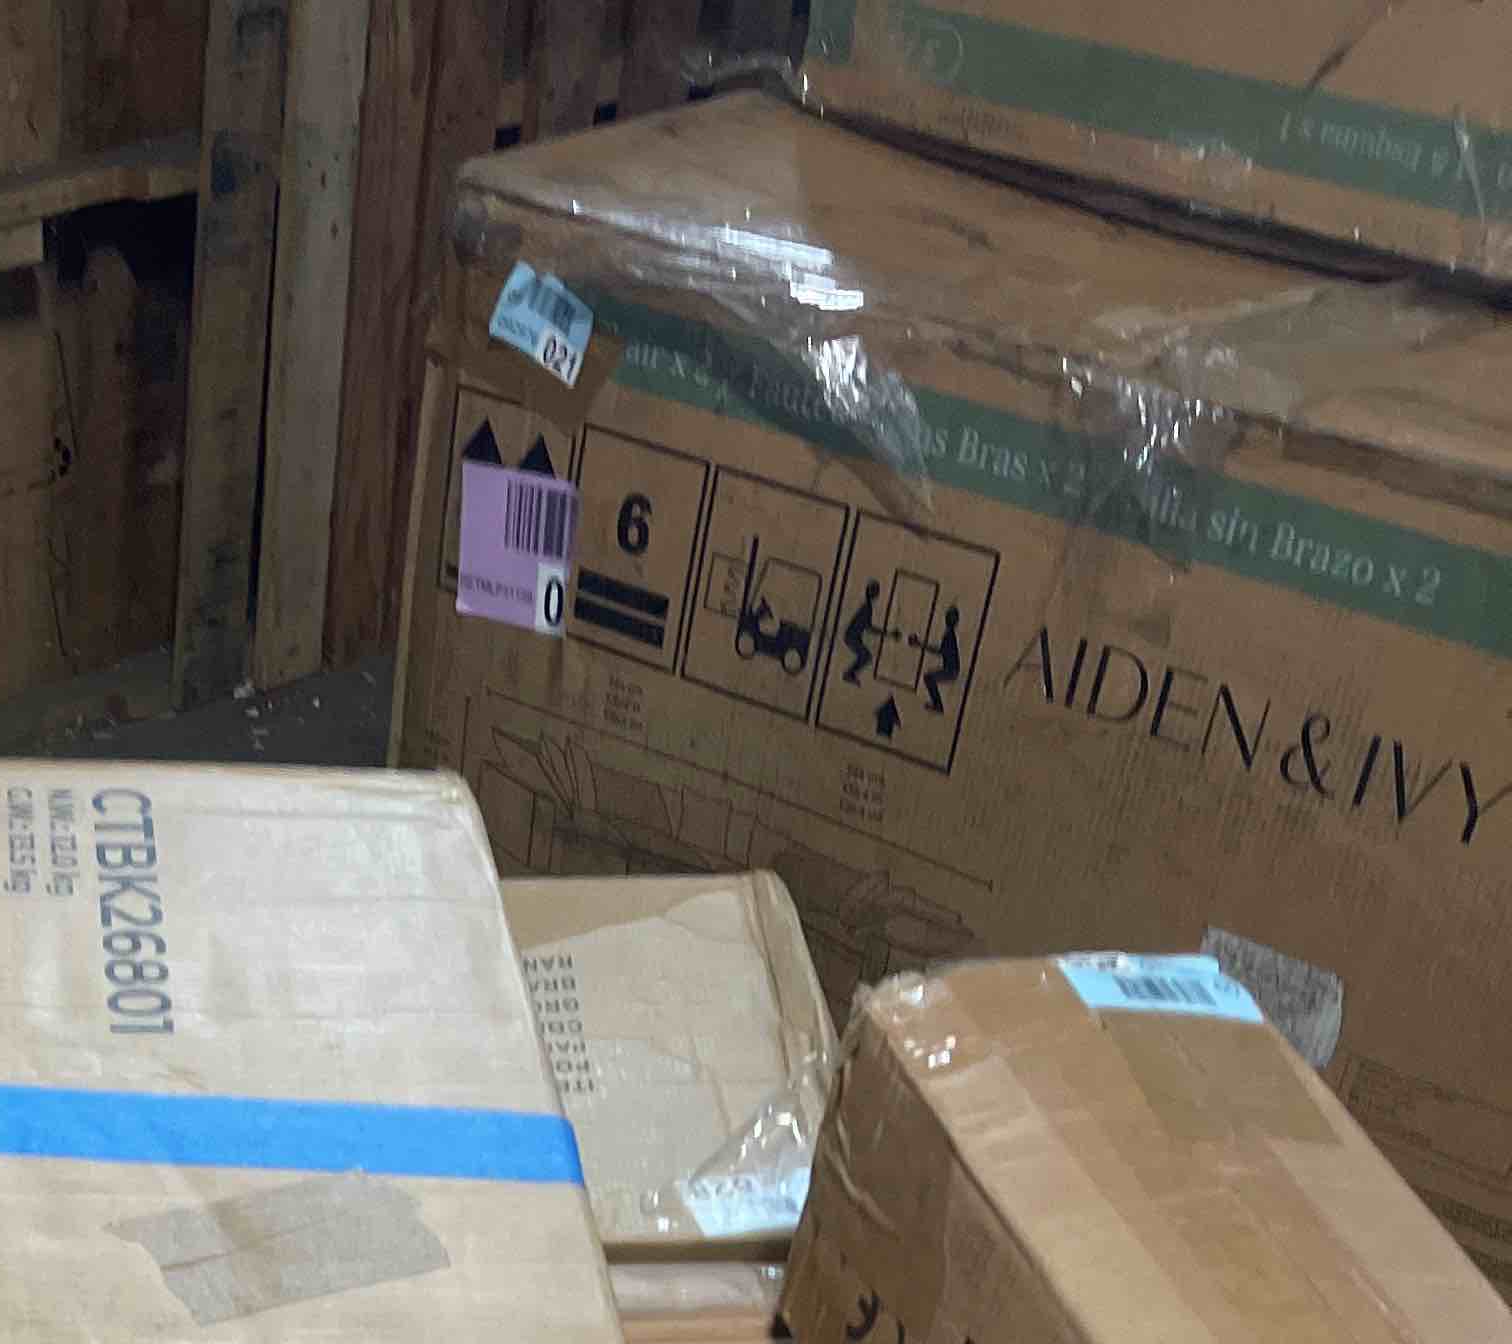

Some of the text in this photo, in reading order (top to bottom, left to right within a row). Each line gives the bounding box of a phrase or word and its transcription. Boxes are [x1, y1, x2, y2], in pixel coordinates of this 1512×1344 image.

[616, 494, 653, 554] 6
[1207, 506, 1258, 553] sin
[1271, 520, 1375, 586] Brazo
[1384, 566, 1408, 597] x
[1414, 566, 1441, 606] 2
[543, 577, 564, 627] 0
[1003, 626, 1512, 847] AIDEN & IVY
[91, 787, 175, 1035] CTBK26801
